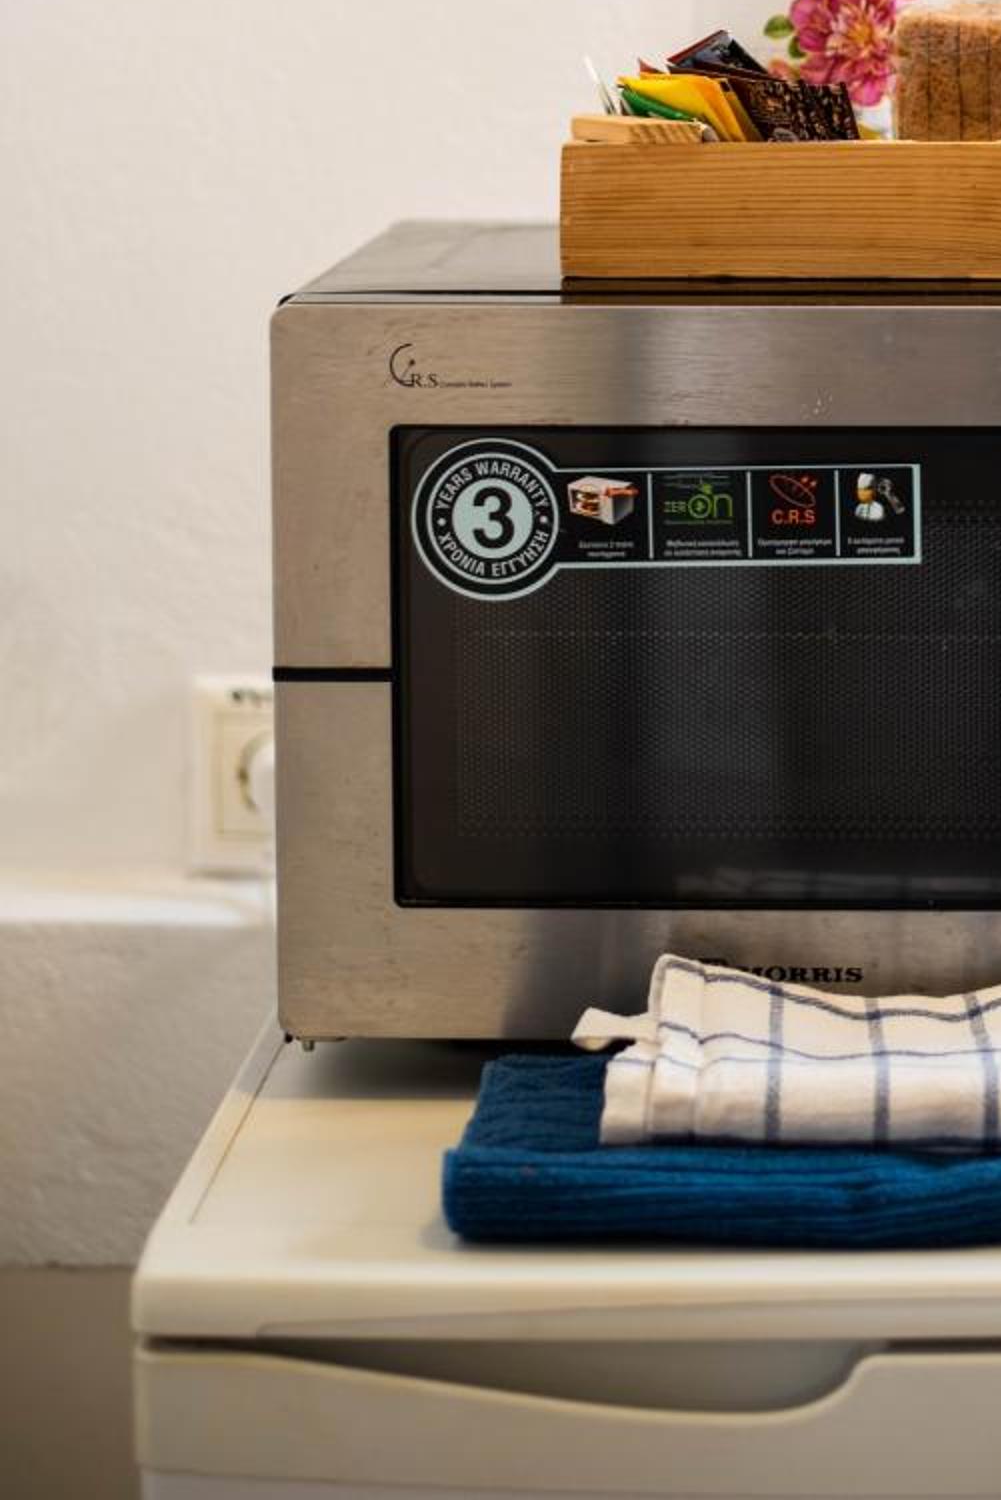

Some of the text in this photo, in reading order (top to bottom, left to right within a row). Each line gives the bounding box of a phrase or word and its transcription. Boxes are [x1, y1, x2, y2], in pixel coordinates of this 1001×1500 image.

[435, 460, 549, 509] YEARS WARRANTY
[473, 486, 515, 549] 3
[438, 530, 549, 577] ΧΡΟΝΙΑ ΕΓΓΥΗΣΗ
